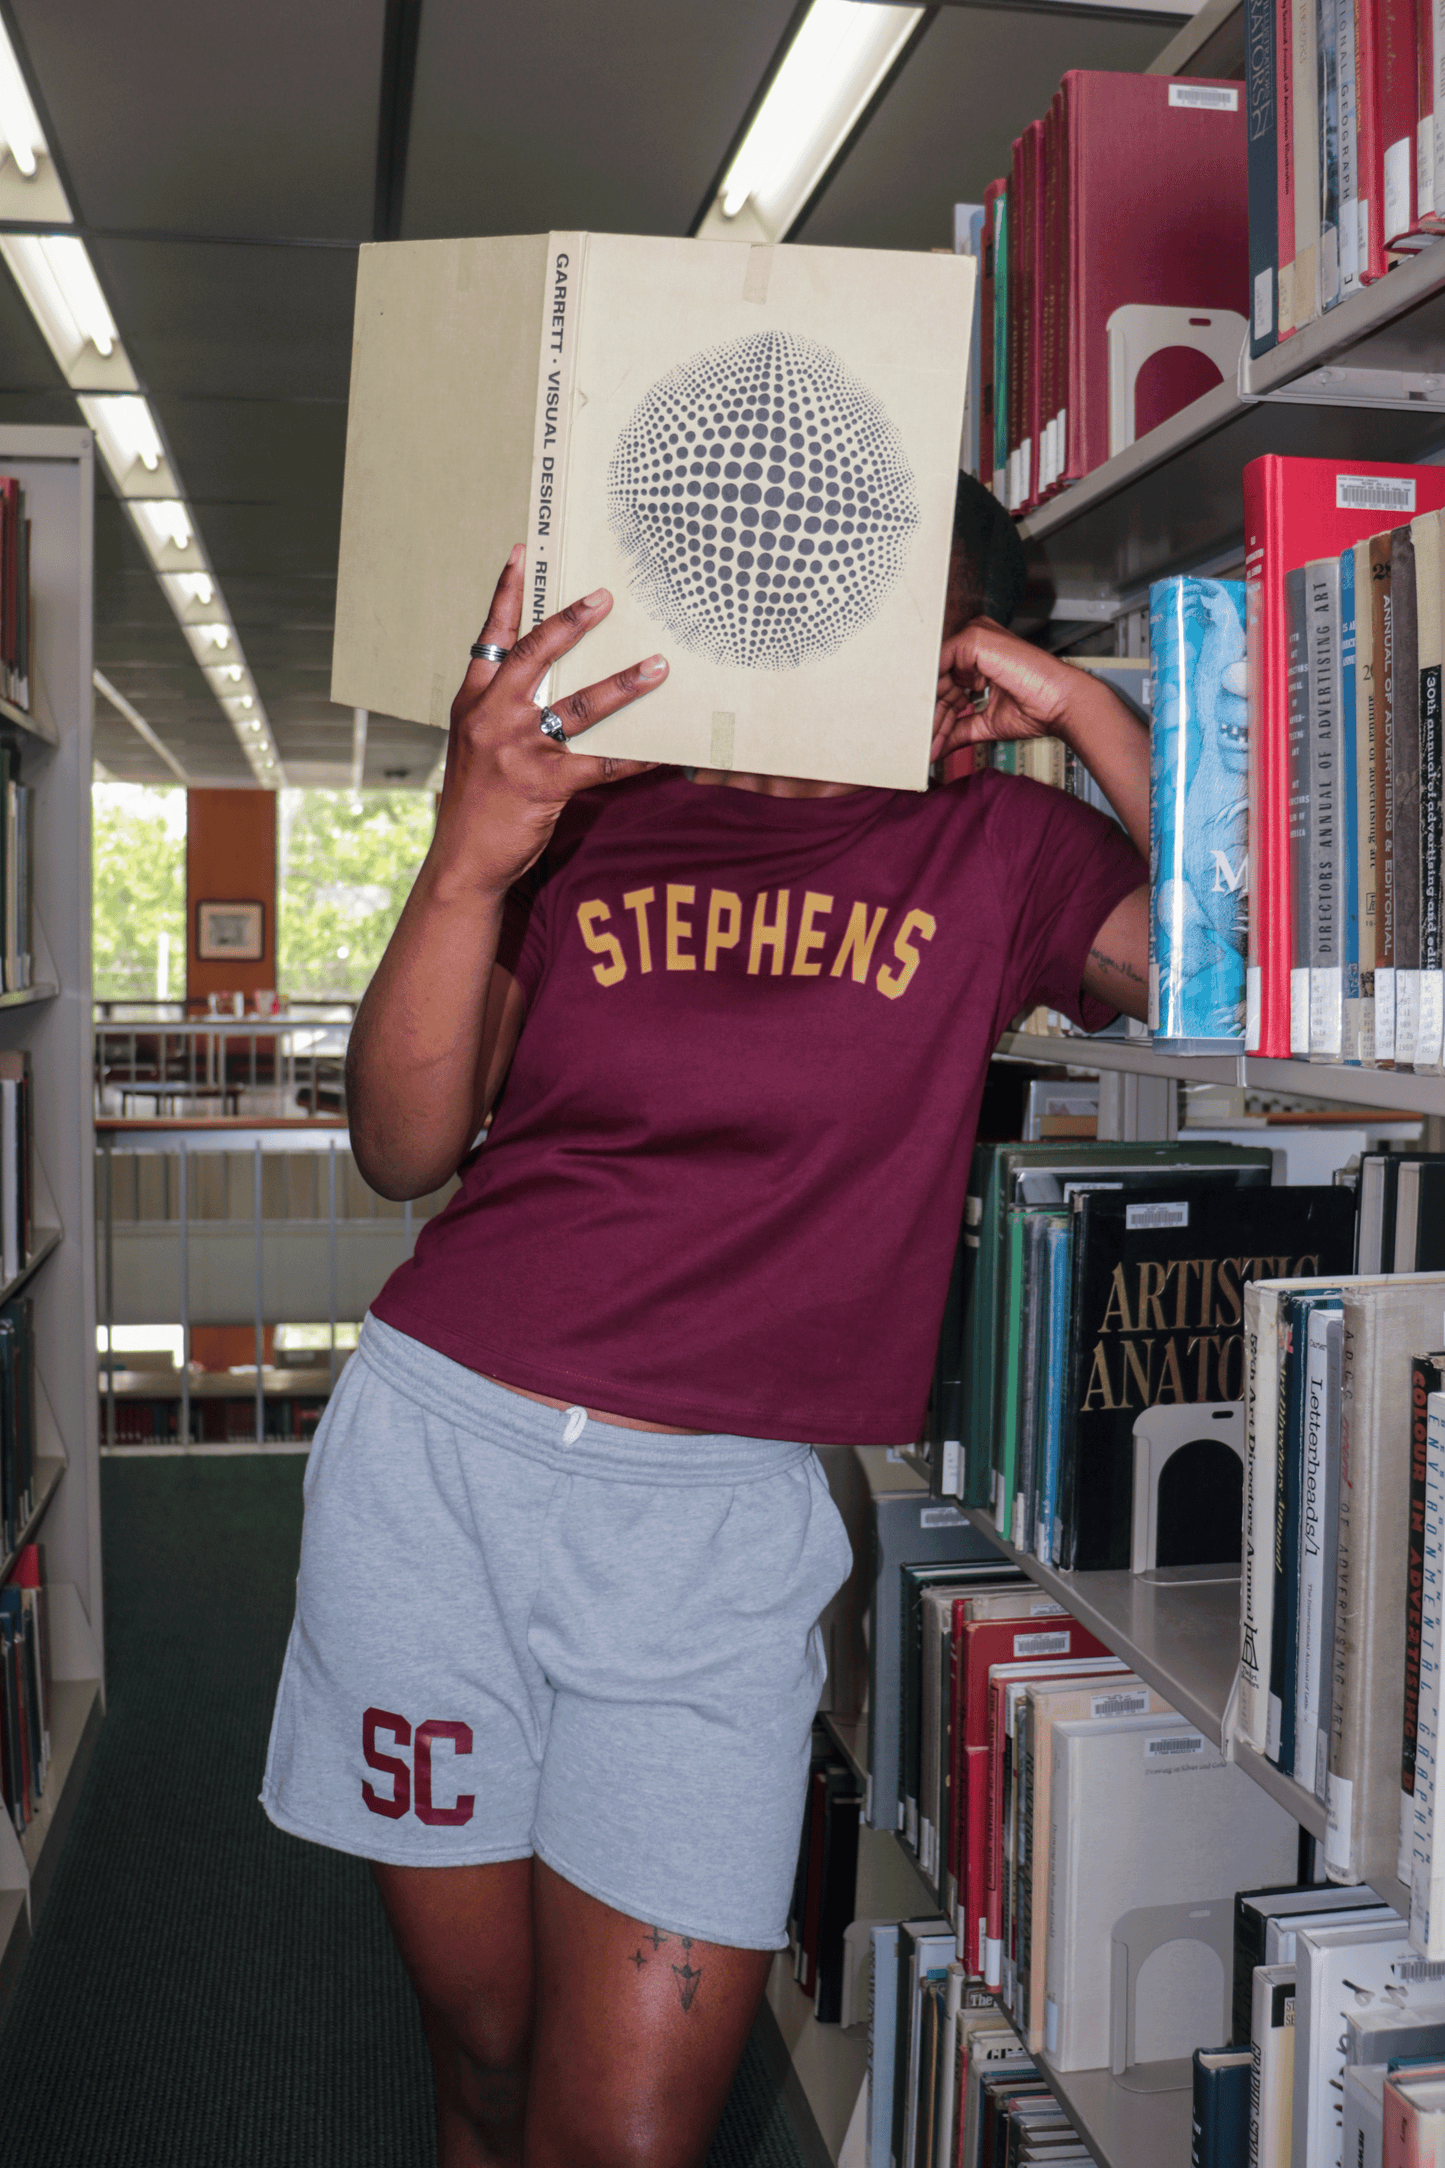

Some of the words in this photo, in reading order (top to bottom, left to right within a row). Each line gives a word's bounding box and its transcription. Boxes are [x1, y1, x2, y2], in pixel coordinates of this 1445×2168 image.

[550, 252, 570, 355] GARRETT
[543, 369, 562, 451] VISUAL
[537, 455, 555, 538] DESIGN
[1313, 581, 1329, 614] ART
[1383, 594, 1393, 672] ANNUAL
[1315, 626, 1331, 740] ADVERTISING
[1384, 679, 1393, 704] OF
[1426, 677, 1438, 716] 30th
[1317, 752, 1332, 770] OF
[1384, 710, 1394, 832] ADVERTISING
[1426, 719, 1438, 782] annual
[1317, 781, 1332, 849] ANNUAL
[1427, 784, 1438, 799] of
[1384, 839, 1394, 852] &
[1423, 802, 1438, 897] advertising
[576, 883, 937, 1000] STEPHENS
[1318, 861, 1332, 953] DIRECTORS
[1384, 860, 1394, 956] EDITORIAL
[1426, 903, 1438, 933] and
[1097, 1254, 1319, 1334] ARTIS
[1247, 1387, 1257, 1428] Art
[1278, 1367, 1287, 1396] Art
[1412, 1369, 1427, 1482] COLOUR
[1246, 1434, 1257, 1537] Directors
[1304, 1376, 1323, 1557] Letterheads/1
[1340, 1502, 1351, 1527] OF
[1410, 1498, 1425, 1533] IN
[1420, 1414, 1440, 1691] ENVIRONMENTAL
[1245, 1541, 1256, 1622] Annual
[1334, 1543, 1349, 1687] ADVERTISING
[1404, 1545, 1423, 1739] ADVERTISING
[1332, 1701, 1343, 1740] ART
[361, 1706, 476, 1826] SC
[1412, 1722, 1431, 1865] GRAPHIC
[969, 1993, 994, 2007] The
[1250, 2040, 1262, 2117] GRAPHIC
